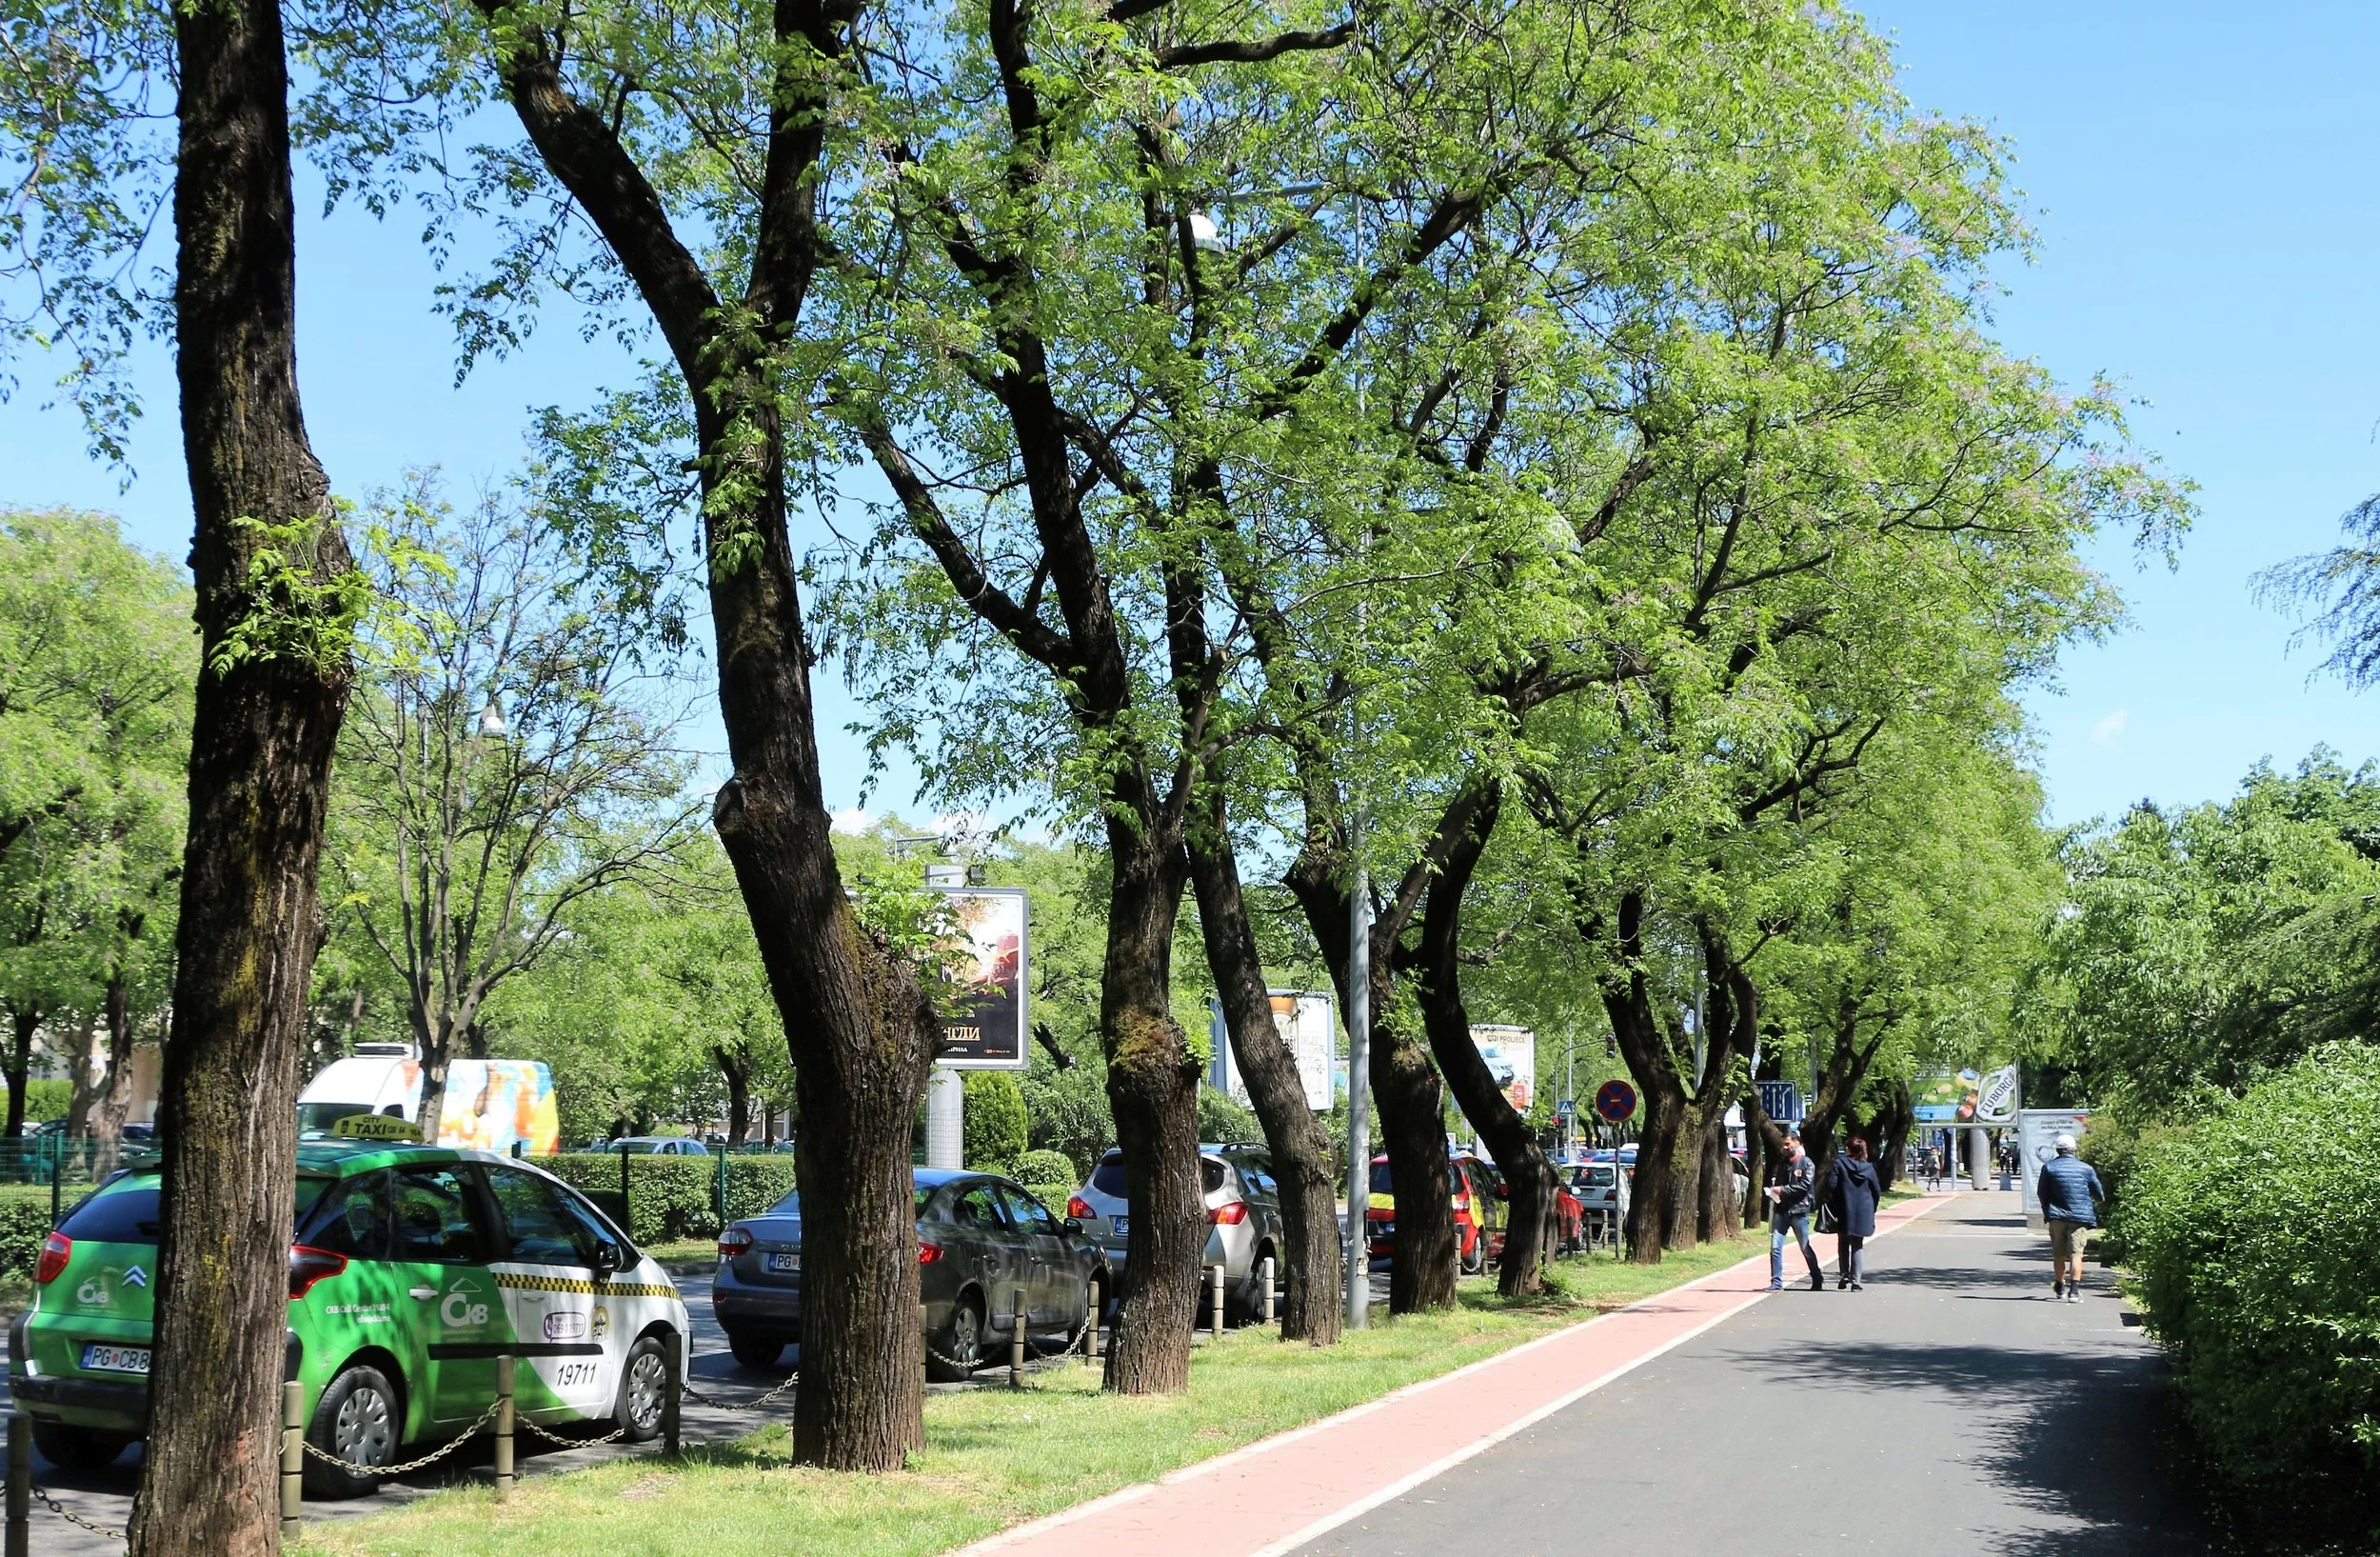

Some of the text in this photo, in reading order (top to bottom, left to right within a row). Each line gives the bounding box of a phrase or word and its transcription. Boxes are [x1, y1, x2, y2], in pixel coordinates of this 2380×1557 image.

[1981, 1076, 2014, 1114] TUBORG
[355, 1123, 387, 1135] TAXI
[777, 1255, 791, 1268] PG
[441, 1292, 488, 1327] CKB
[91, 1347, 111, 1366] PG
[557, 1363, 597, 1387] 19711
